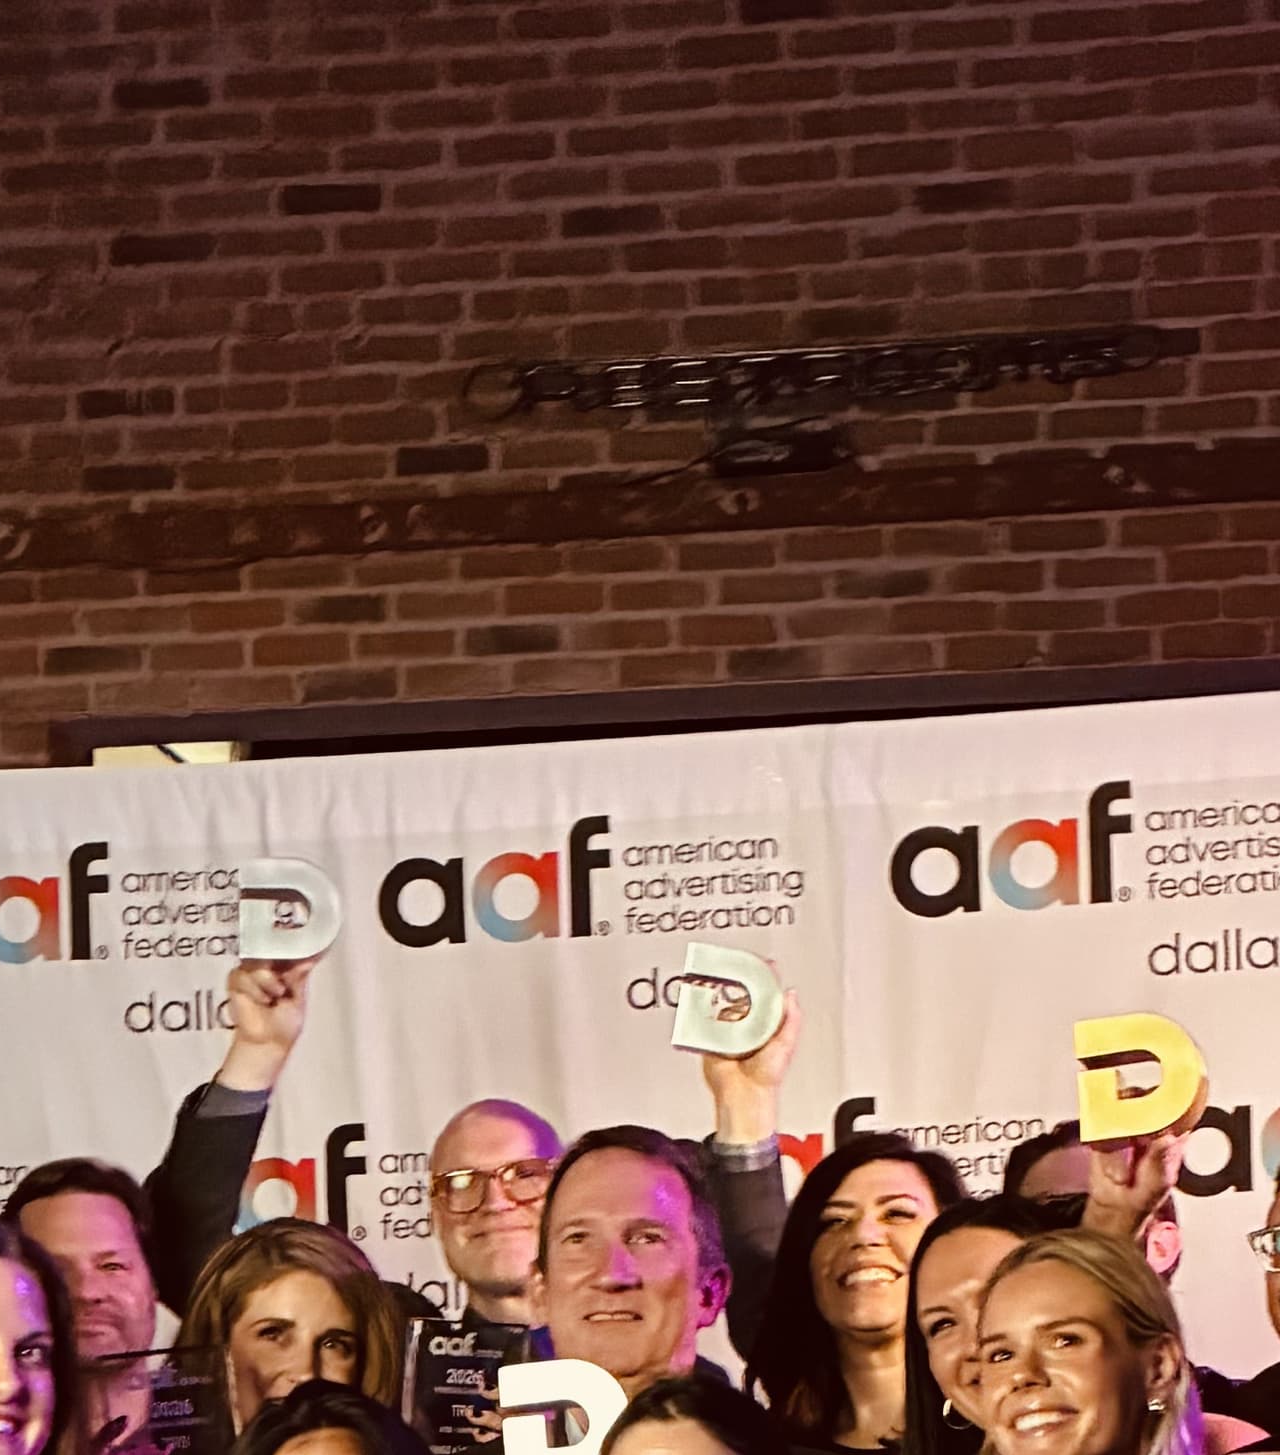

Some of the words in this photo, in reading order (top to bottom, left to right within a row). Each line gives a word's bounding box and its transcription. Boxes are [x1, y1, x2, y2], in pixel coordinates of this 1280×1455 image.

[623, 834, 778, 867] american
[890, 780, 1132, 918] aaf
[121, 865, 239, 893] americ
[379, 815, 610, 948] aaf
[624, 864, 805, 900] advertising
[625, 901, 795, 934] federation
[428, 1332, 478, 1357] aaf
